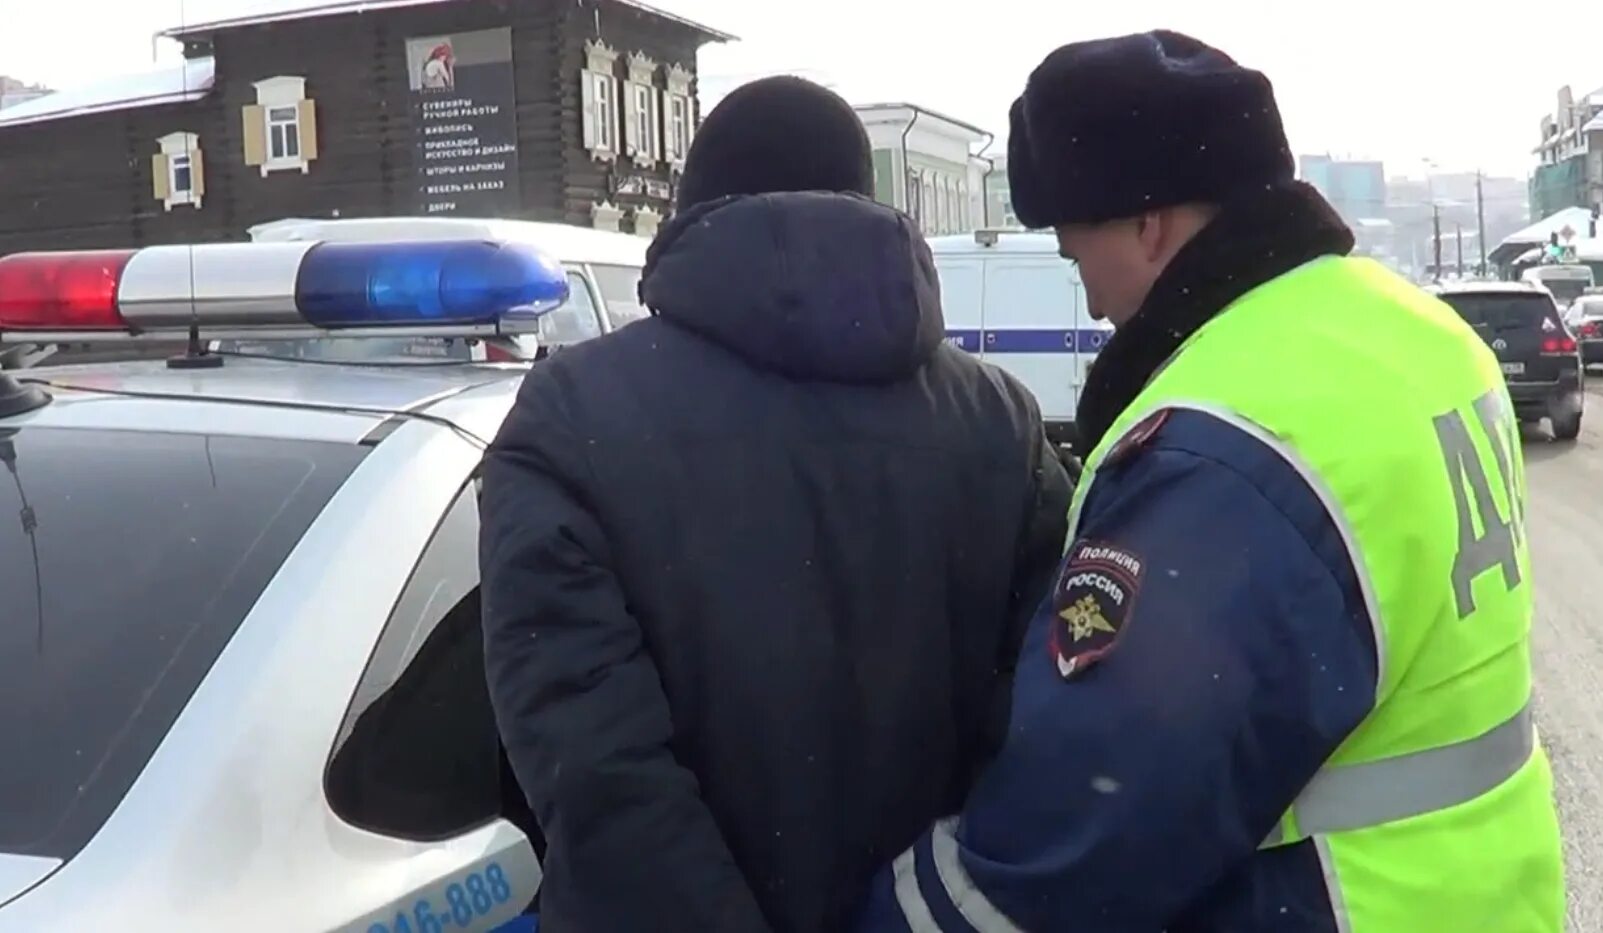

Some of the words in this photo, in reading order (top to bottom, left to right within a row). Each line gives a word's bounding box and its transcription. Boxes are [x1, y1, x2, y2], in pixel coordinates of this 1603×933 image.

[423, 99, 472, 111] СУВЕНИРЫ
[423, 108, 459, 120] РУЧНОЙ
[461, 105, 498, 116] РАБОТЫ
[425, 123, 473, 135] ЖИВОПИСЬ
[425, 137, 479, 149] ПРИКЛАДНОЕ
[425, 148, 473, 160] ИСКУССТВО
[482, 144, 516, 155] ДИЗАЙН
[426, 165, 457, 176] ШТОРЫ
[465, 160, 505, 172] КАРНИЗЫ
[427, 183, 462, 195] МЕБЕЛЬ
[463, 181, 475, 191] НА
[477, 180, 504, 190] ЗАКАЗ
[428, 202, 456, 213] ДВЕРИ
[1078, 546, 1141, 576] ПОЛИЦИЯ
[1066, 573, 1124, 606] РОССИЯ
[366, 862, 511, 933] 16-888
